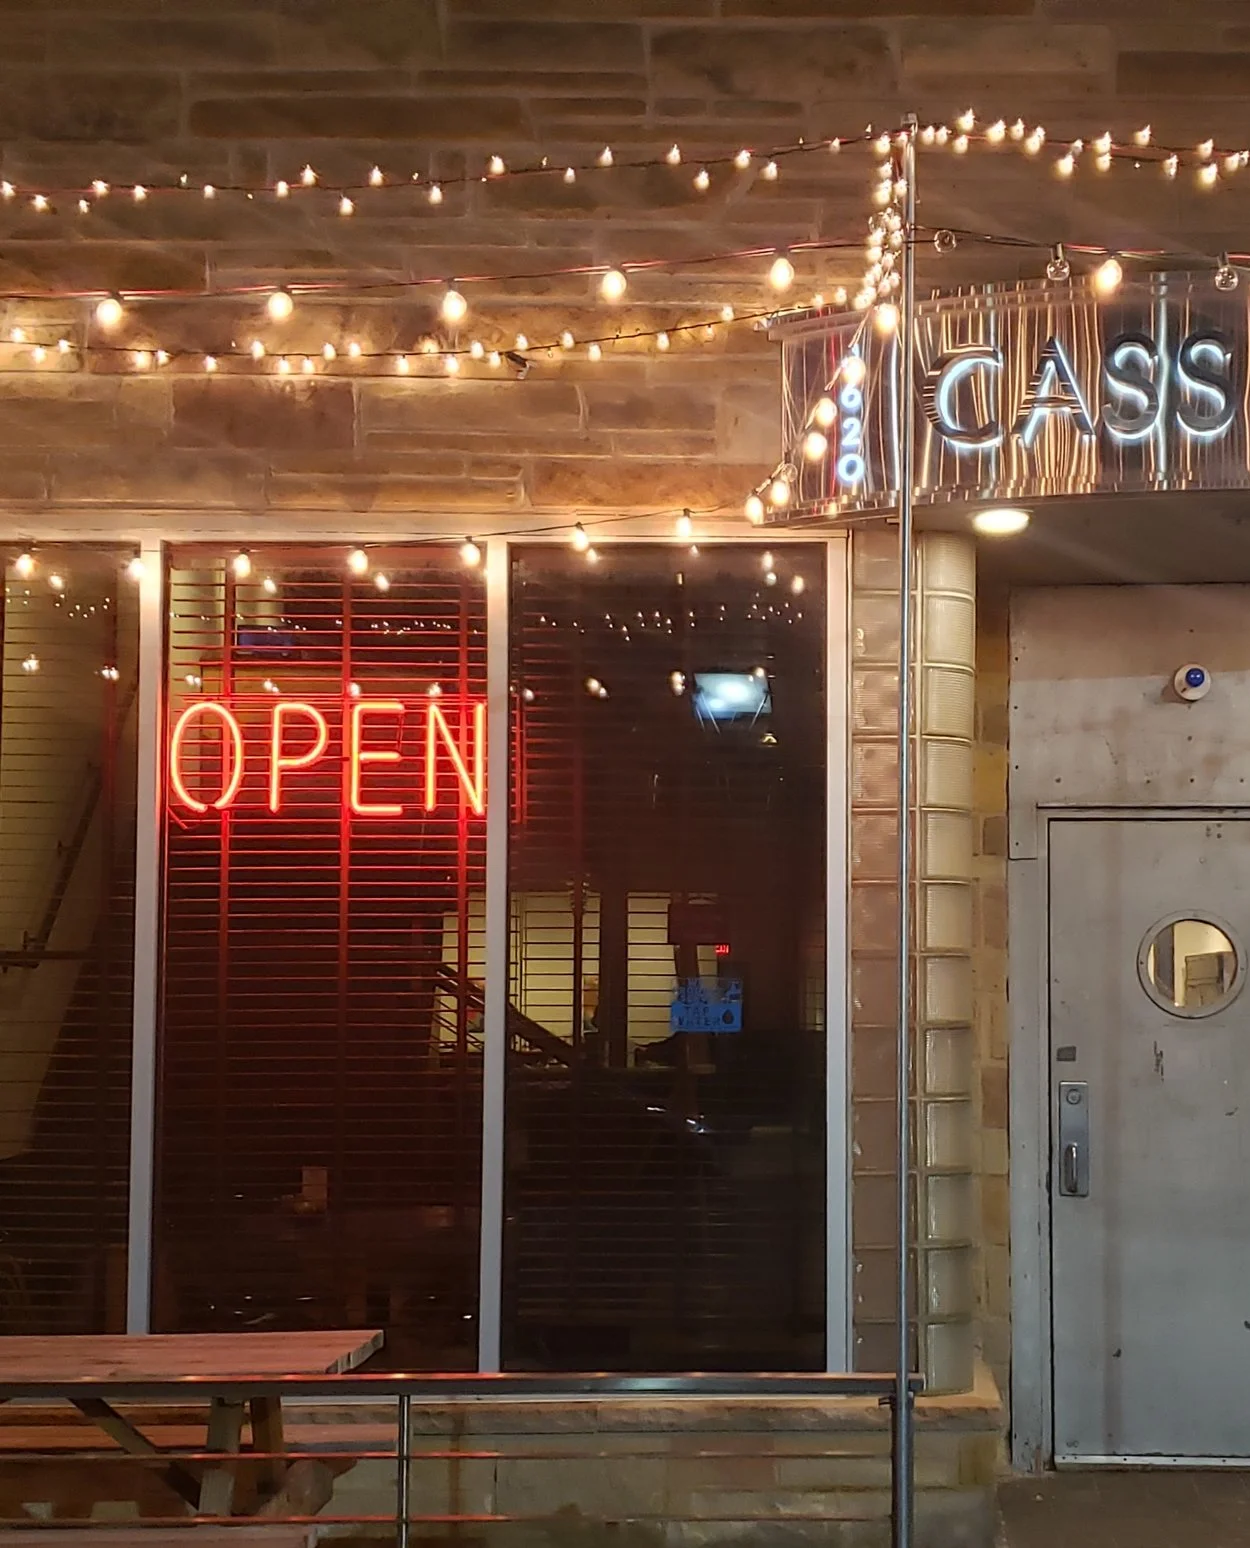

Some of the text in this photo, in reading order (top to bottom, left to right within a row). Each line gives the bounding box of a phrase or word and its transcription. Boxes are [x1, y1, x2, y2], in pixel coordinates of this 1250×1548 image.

[837, 343, 865, 483] 620
[922, 331, 1234, 447] CASS
[170, 702, 486, 815] OPEN
